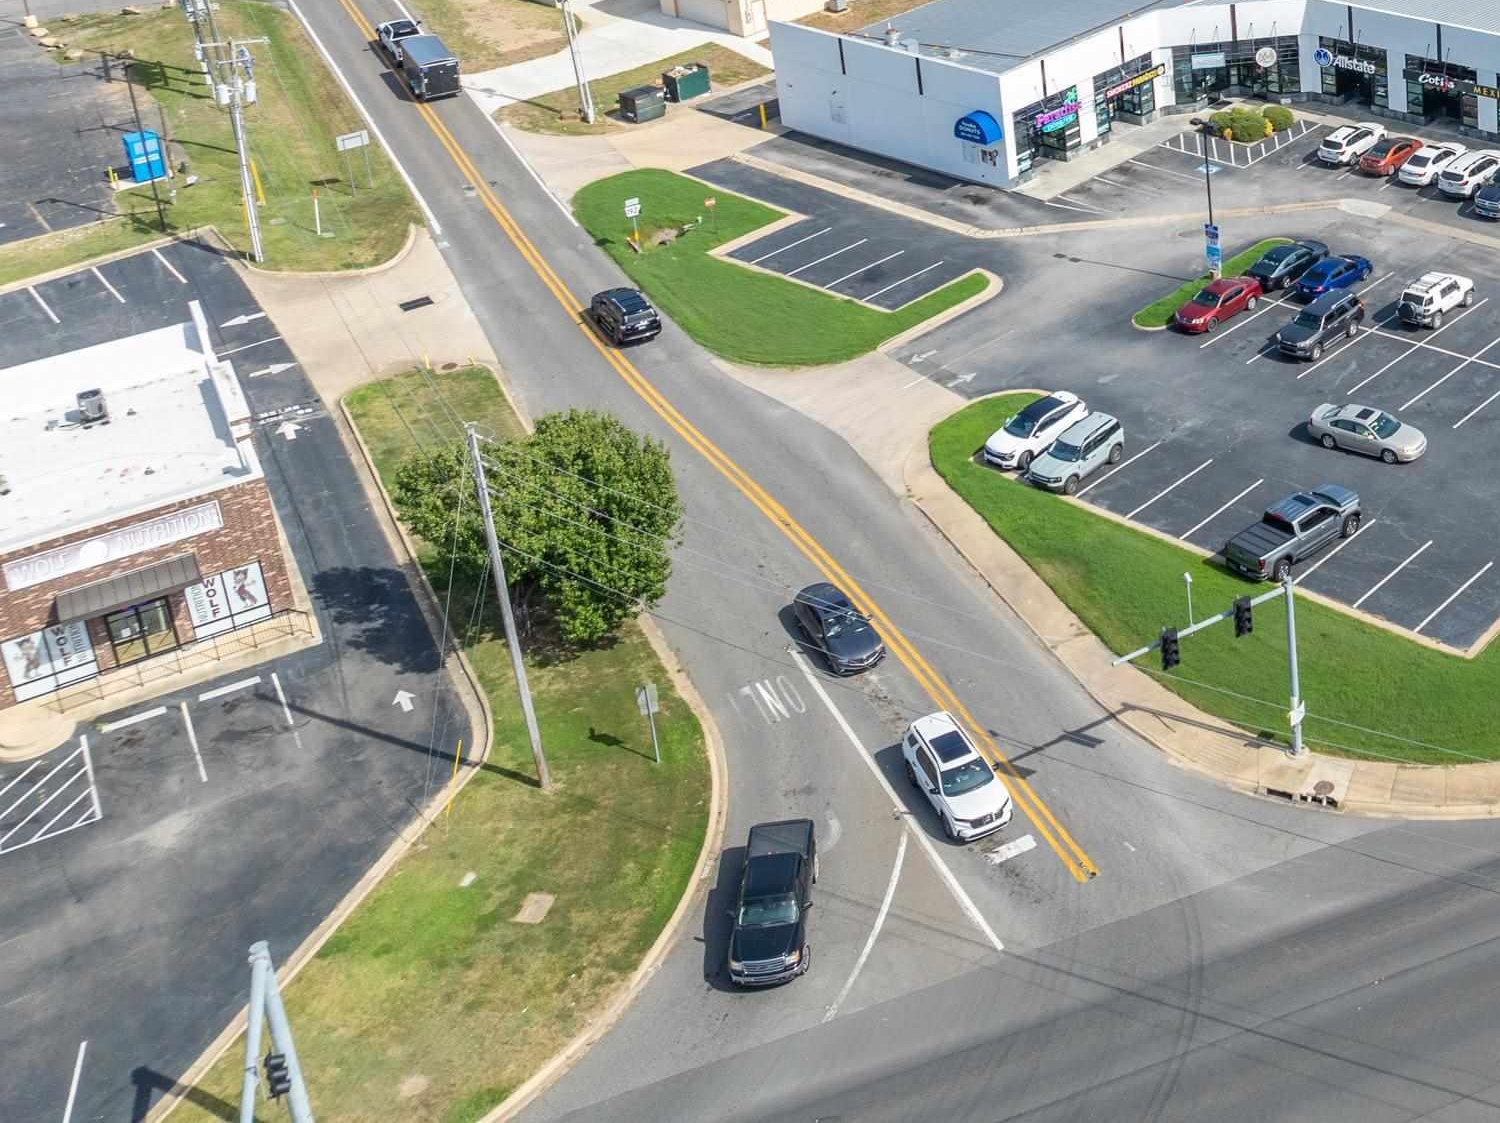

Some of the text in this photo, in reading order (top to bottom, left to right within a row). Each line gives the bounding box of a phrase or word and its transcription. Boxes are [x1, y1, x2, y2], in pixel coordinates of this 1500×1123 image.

[1333, 55, 1376, 74] Allstate
[13, 508, 217, 581] WOLF NUTRITION
[201, 576, 222, 619] WOLF
[50, 625, 72, 667] WOLF
